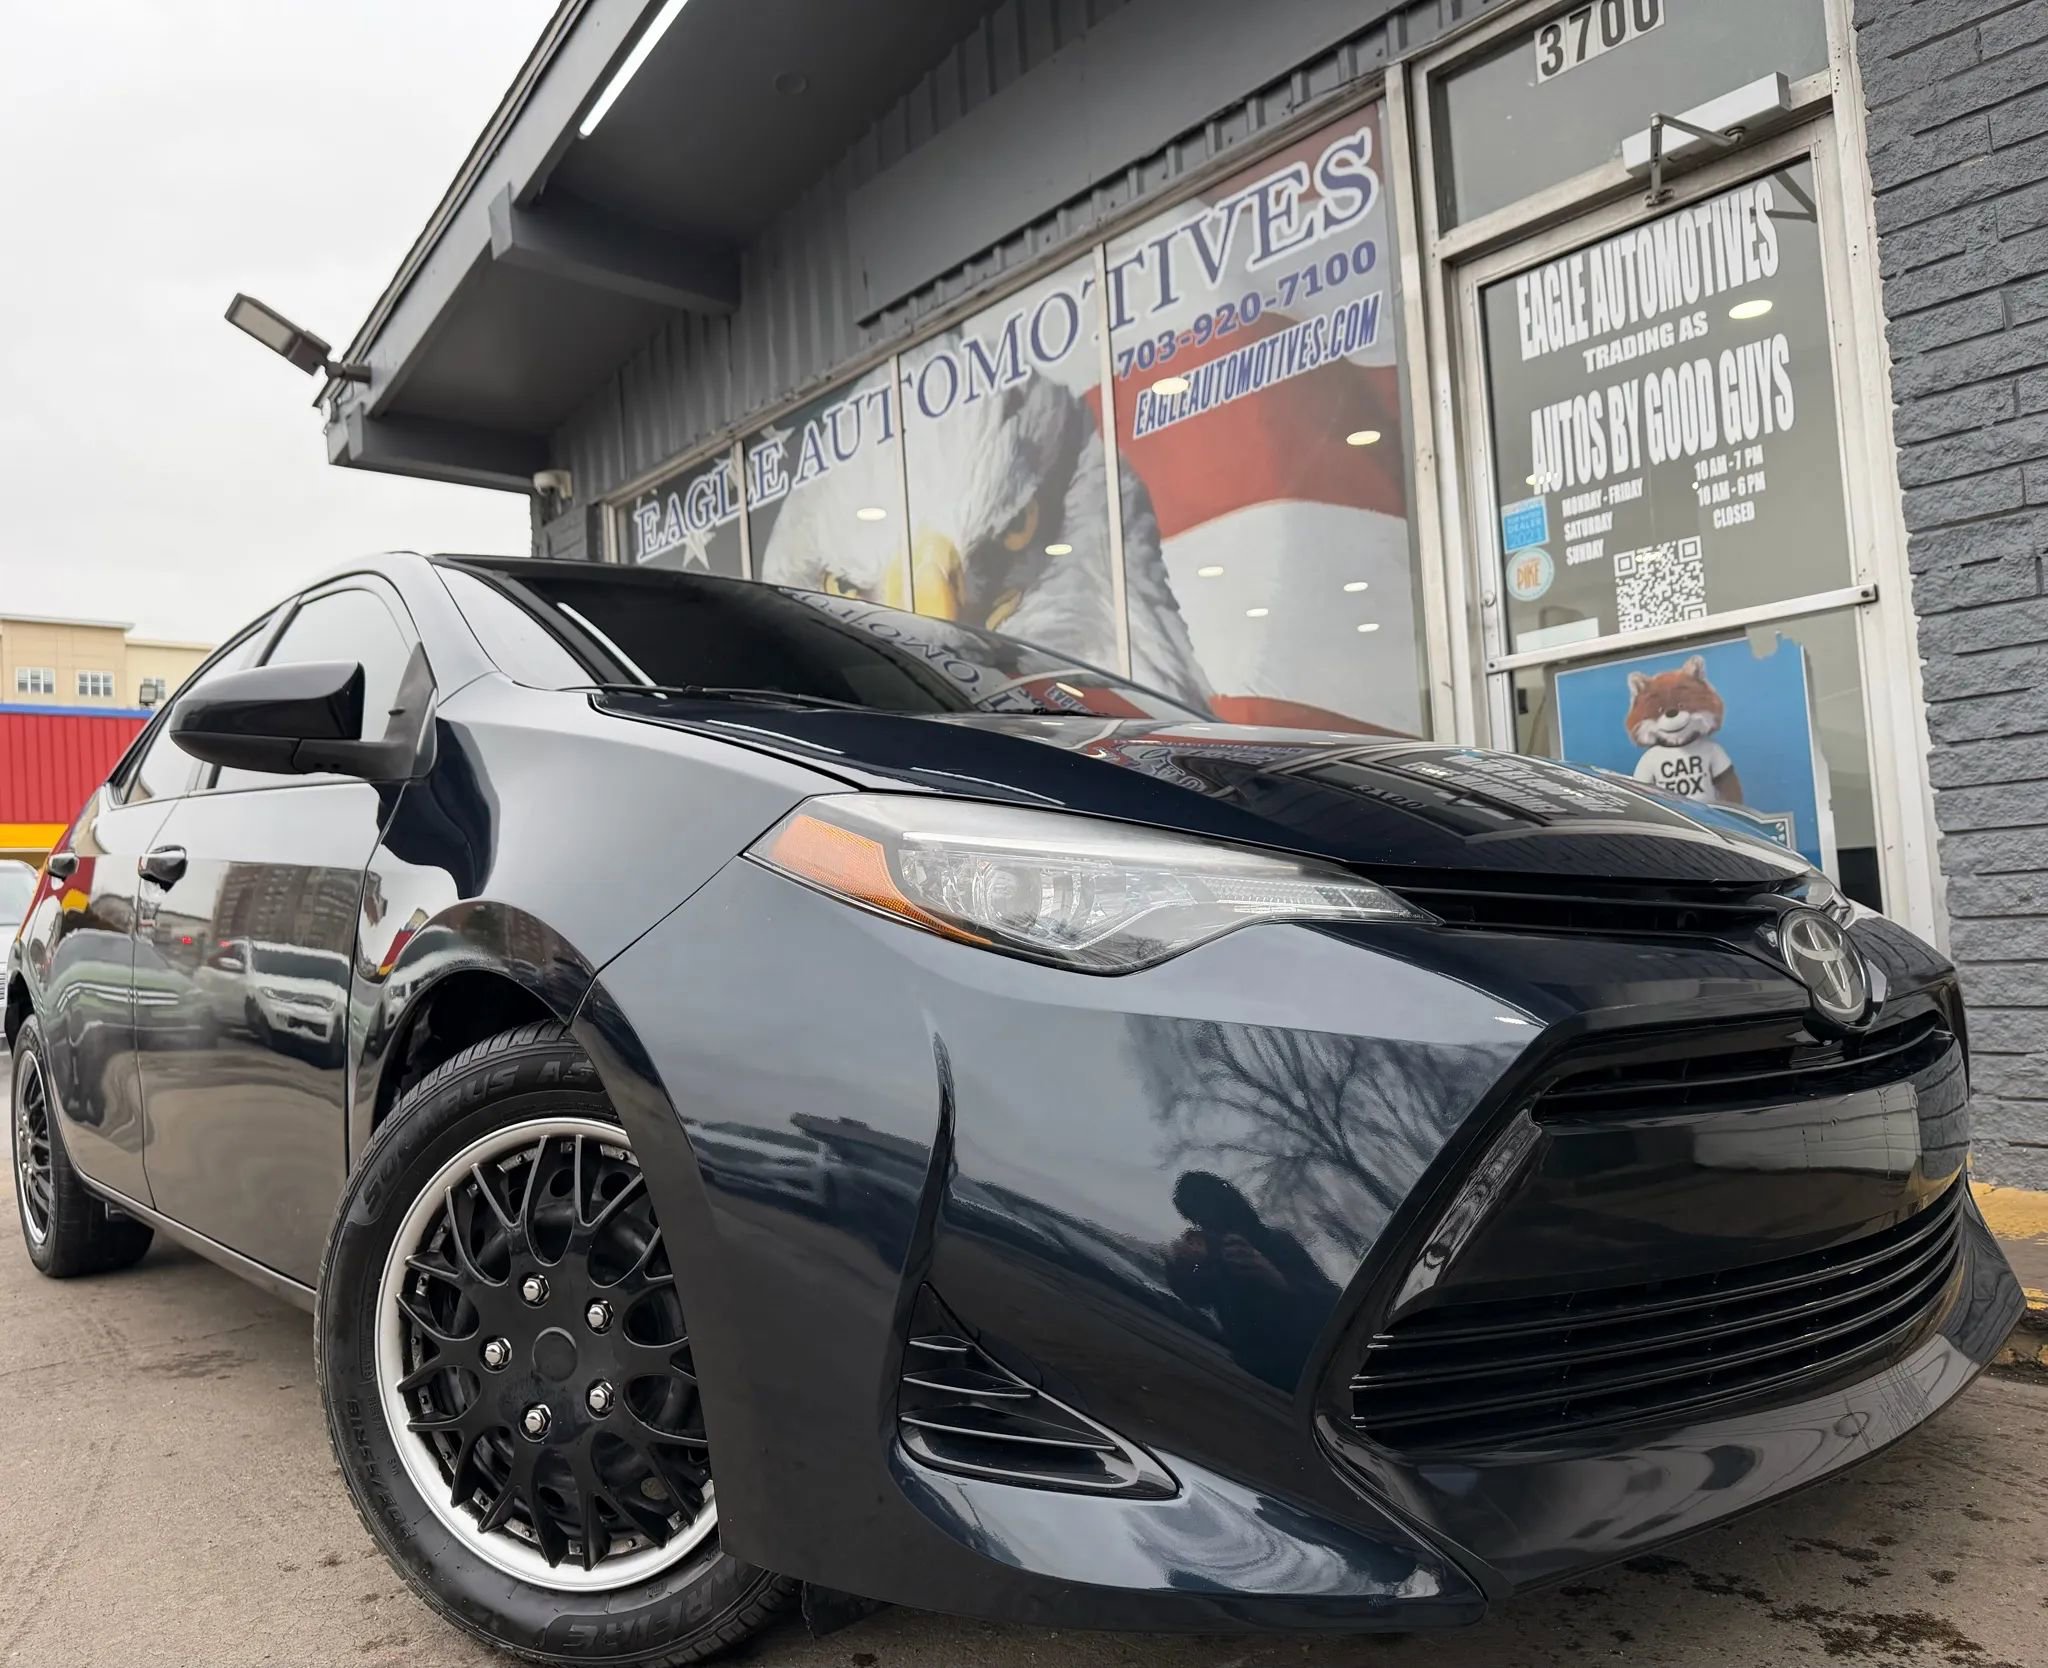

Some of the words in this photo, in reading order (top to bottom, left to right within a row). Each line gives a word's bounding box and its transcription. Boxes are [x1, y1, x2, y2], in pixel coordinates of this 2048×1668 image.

[1540, 0, 1660, 76] 3700
[1516, 254, 1589, 361] EAGLE
[1589, 181, 1779, 336] AUTOMOTIVES
[1118, 240, 1376, 380] 703-920-7100
[636, 438, 788, 561] EAGLE
[794, 128, 1379, 486] AUTOMOTIVES
[1583, 322, 1675, 373] TRADING
[1679, 311, 1708, 342] AS
[1134, 294, 1381, 438] EAGLEAUTOMOTIVES.COM
[1530, 390, 1608, 495] AUTOS
[1607, 379, 1641, 474] BY
[1644, 358, 1718, 465] GOOD
[1719, 333, 1794, 445] GUYS
[1694, 460, 1709, 481] 10
[1709, 455, 1728, 478] AM
[1744, 444, 1764, 468] PM
[1562, 490, 1603, 517] MONDAY
[1608, 478, 1643, 504] FRIDAY
[1697, 486, 1712, 507] 10
[1712, 480, 1730, 503] AM
[1747, 471, 1766, 494] PM
[1564, 511, 1613, 541] SATURDAY
[1713, 501, 1755, 529] CLOSED
[1565, 539, 1604, 566] SUNDAY
[1661, 755, 1703, 778] CAR
[1665, 776, 1704, 795] FOX
